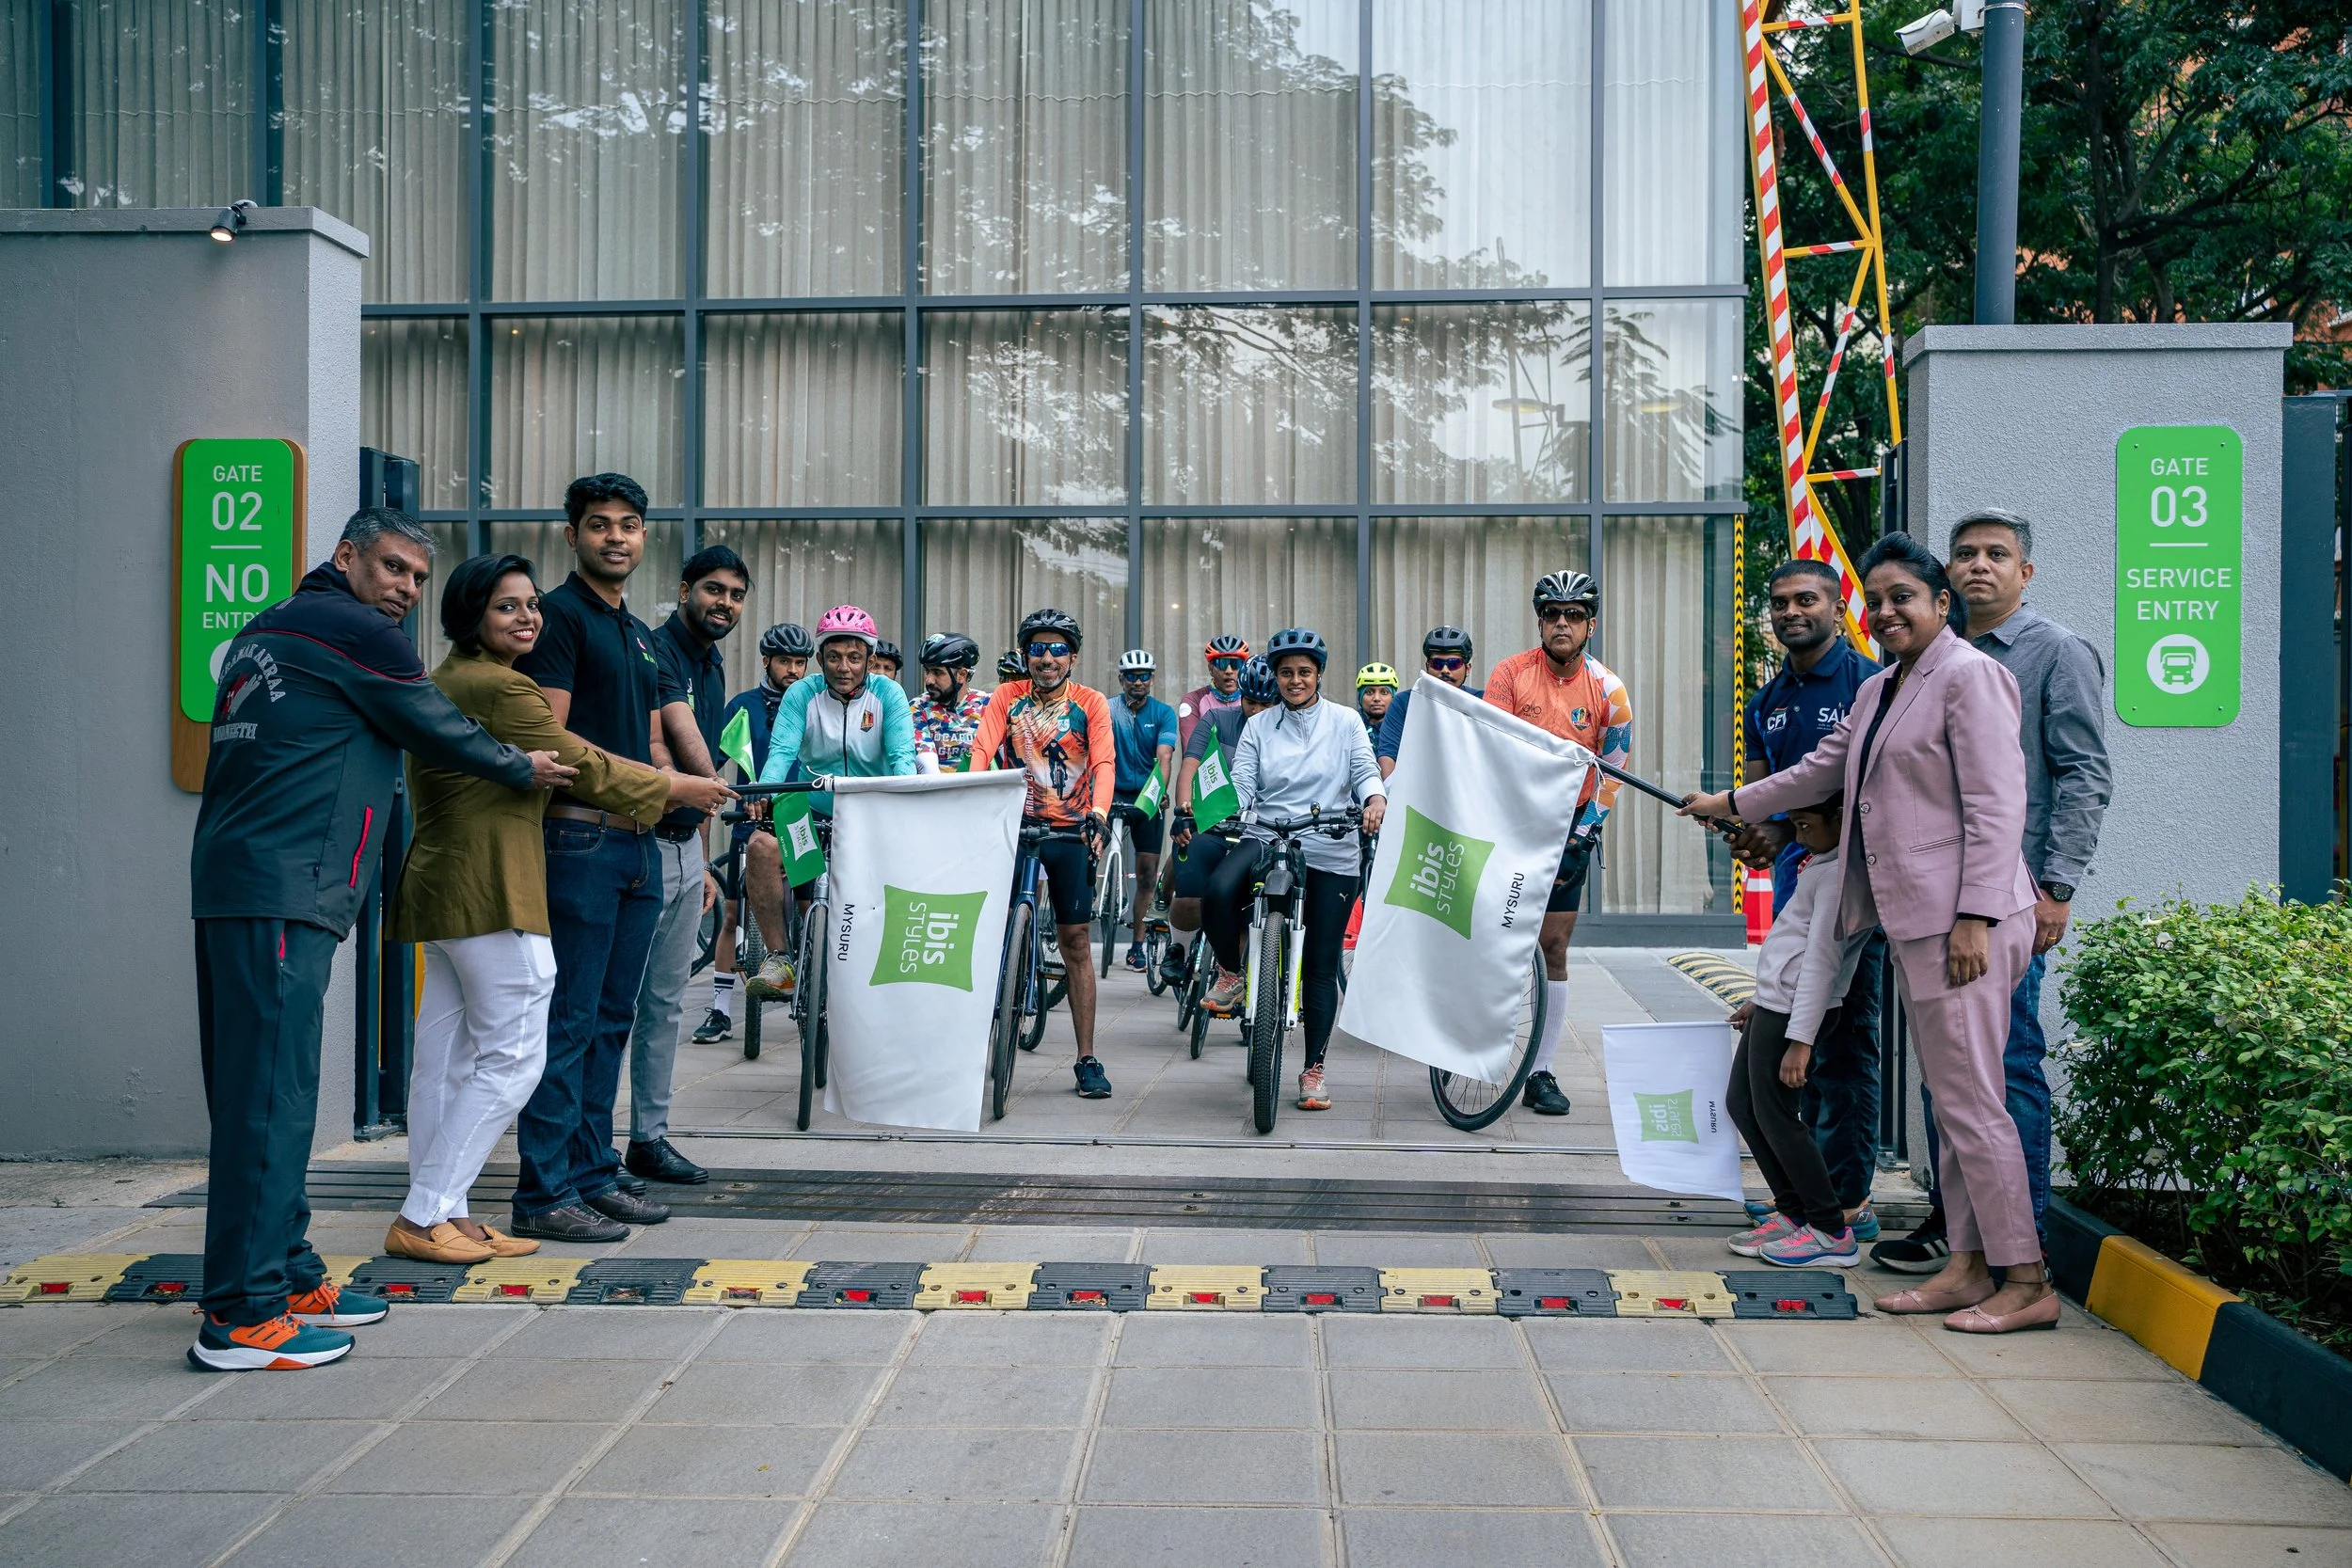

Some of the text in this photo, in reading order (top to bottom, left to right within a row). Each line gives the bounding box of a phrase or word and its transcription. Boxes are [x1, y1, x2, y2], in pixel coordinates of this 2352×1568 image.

[213, 465, 262, 483] GATE
[2150, 457, 2209, 476] GATE
[212, 491, 262, 531] 02
[2150, 485, 2208, 528] 03
[205, 563, 269, 603] NO
[2125, 567, 2232, 588] SERVICE
[202, 611, 259, 629] ENTR
[2137, 600, 2219, 621] ENTRY
[1207, 763, 1218, 784] ibis
[800, 825, 809, 847] ibis
[1409, 842, 1445, 898] ibis
[1501, 872, 1525, 928] MYSURU
[837, 903, 855, 961] MYSURU
[922, 911, 960, 965] ibis
